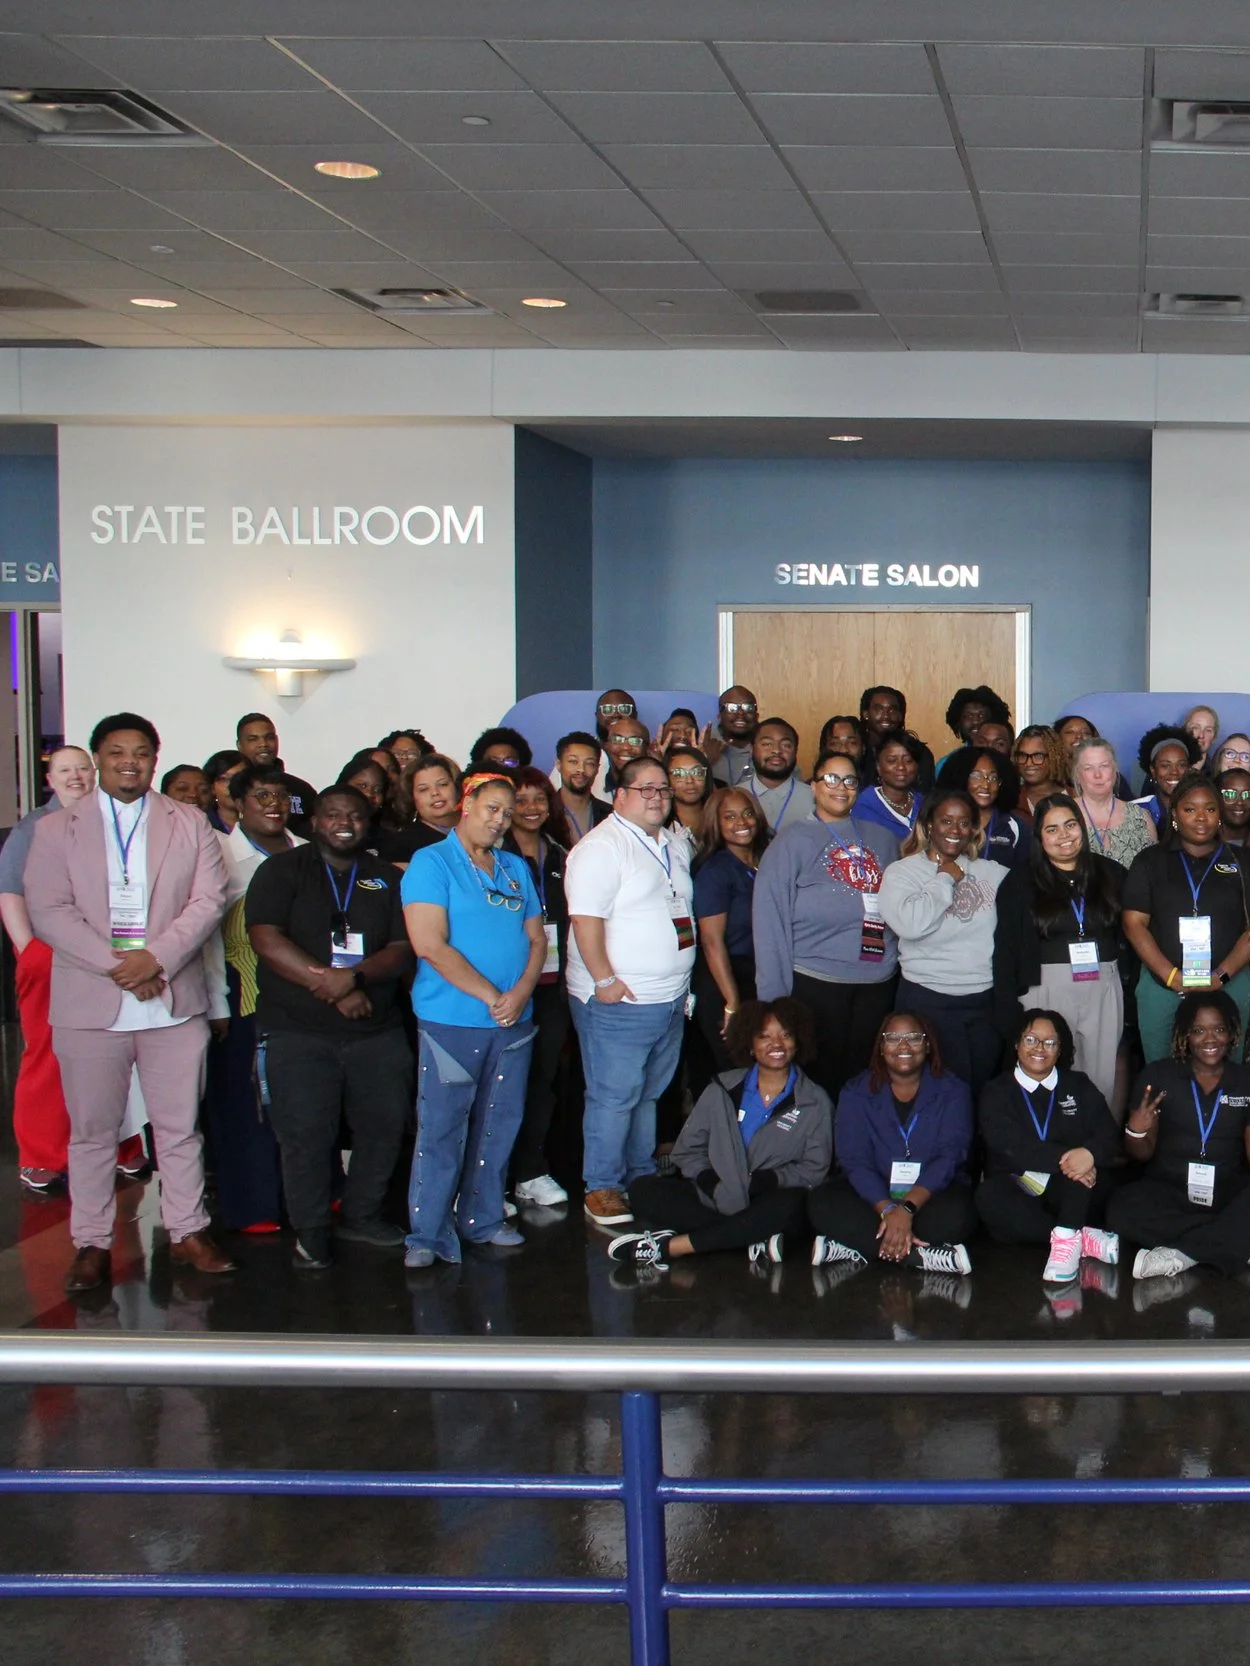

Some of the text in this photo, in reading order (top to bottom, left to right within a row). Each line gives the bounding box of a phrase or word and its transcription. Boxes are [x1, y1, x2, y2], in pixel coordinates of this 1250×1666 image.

[90, 504, 484, 546] STATE BALLROOM
[774, 563, 979, 588] SENATE SALON
